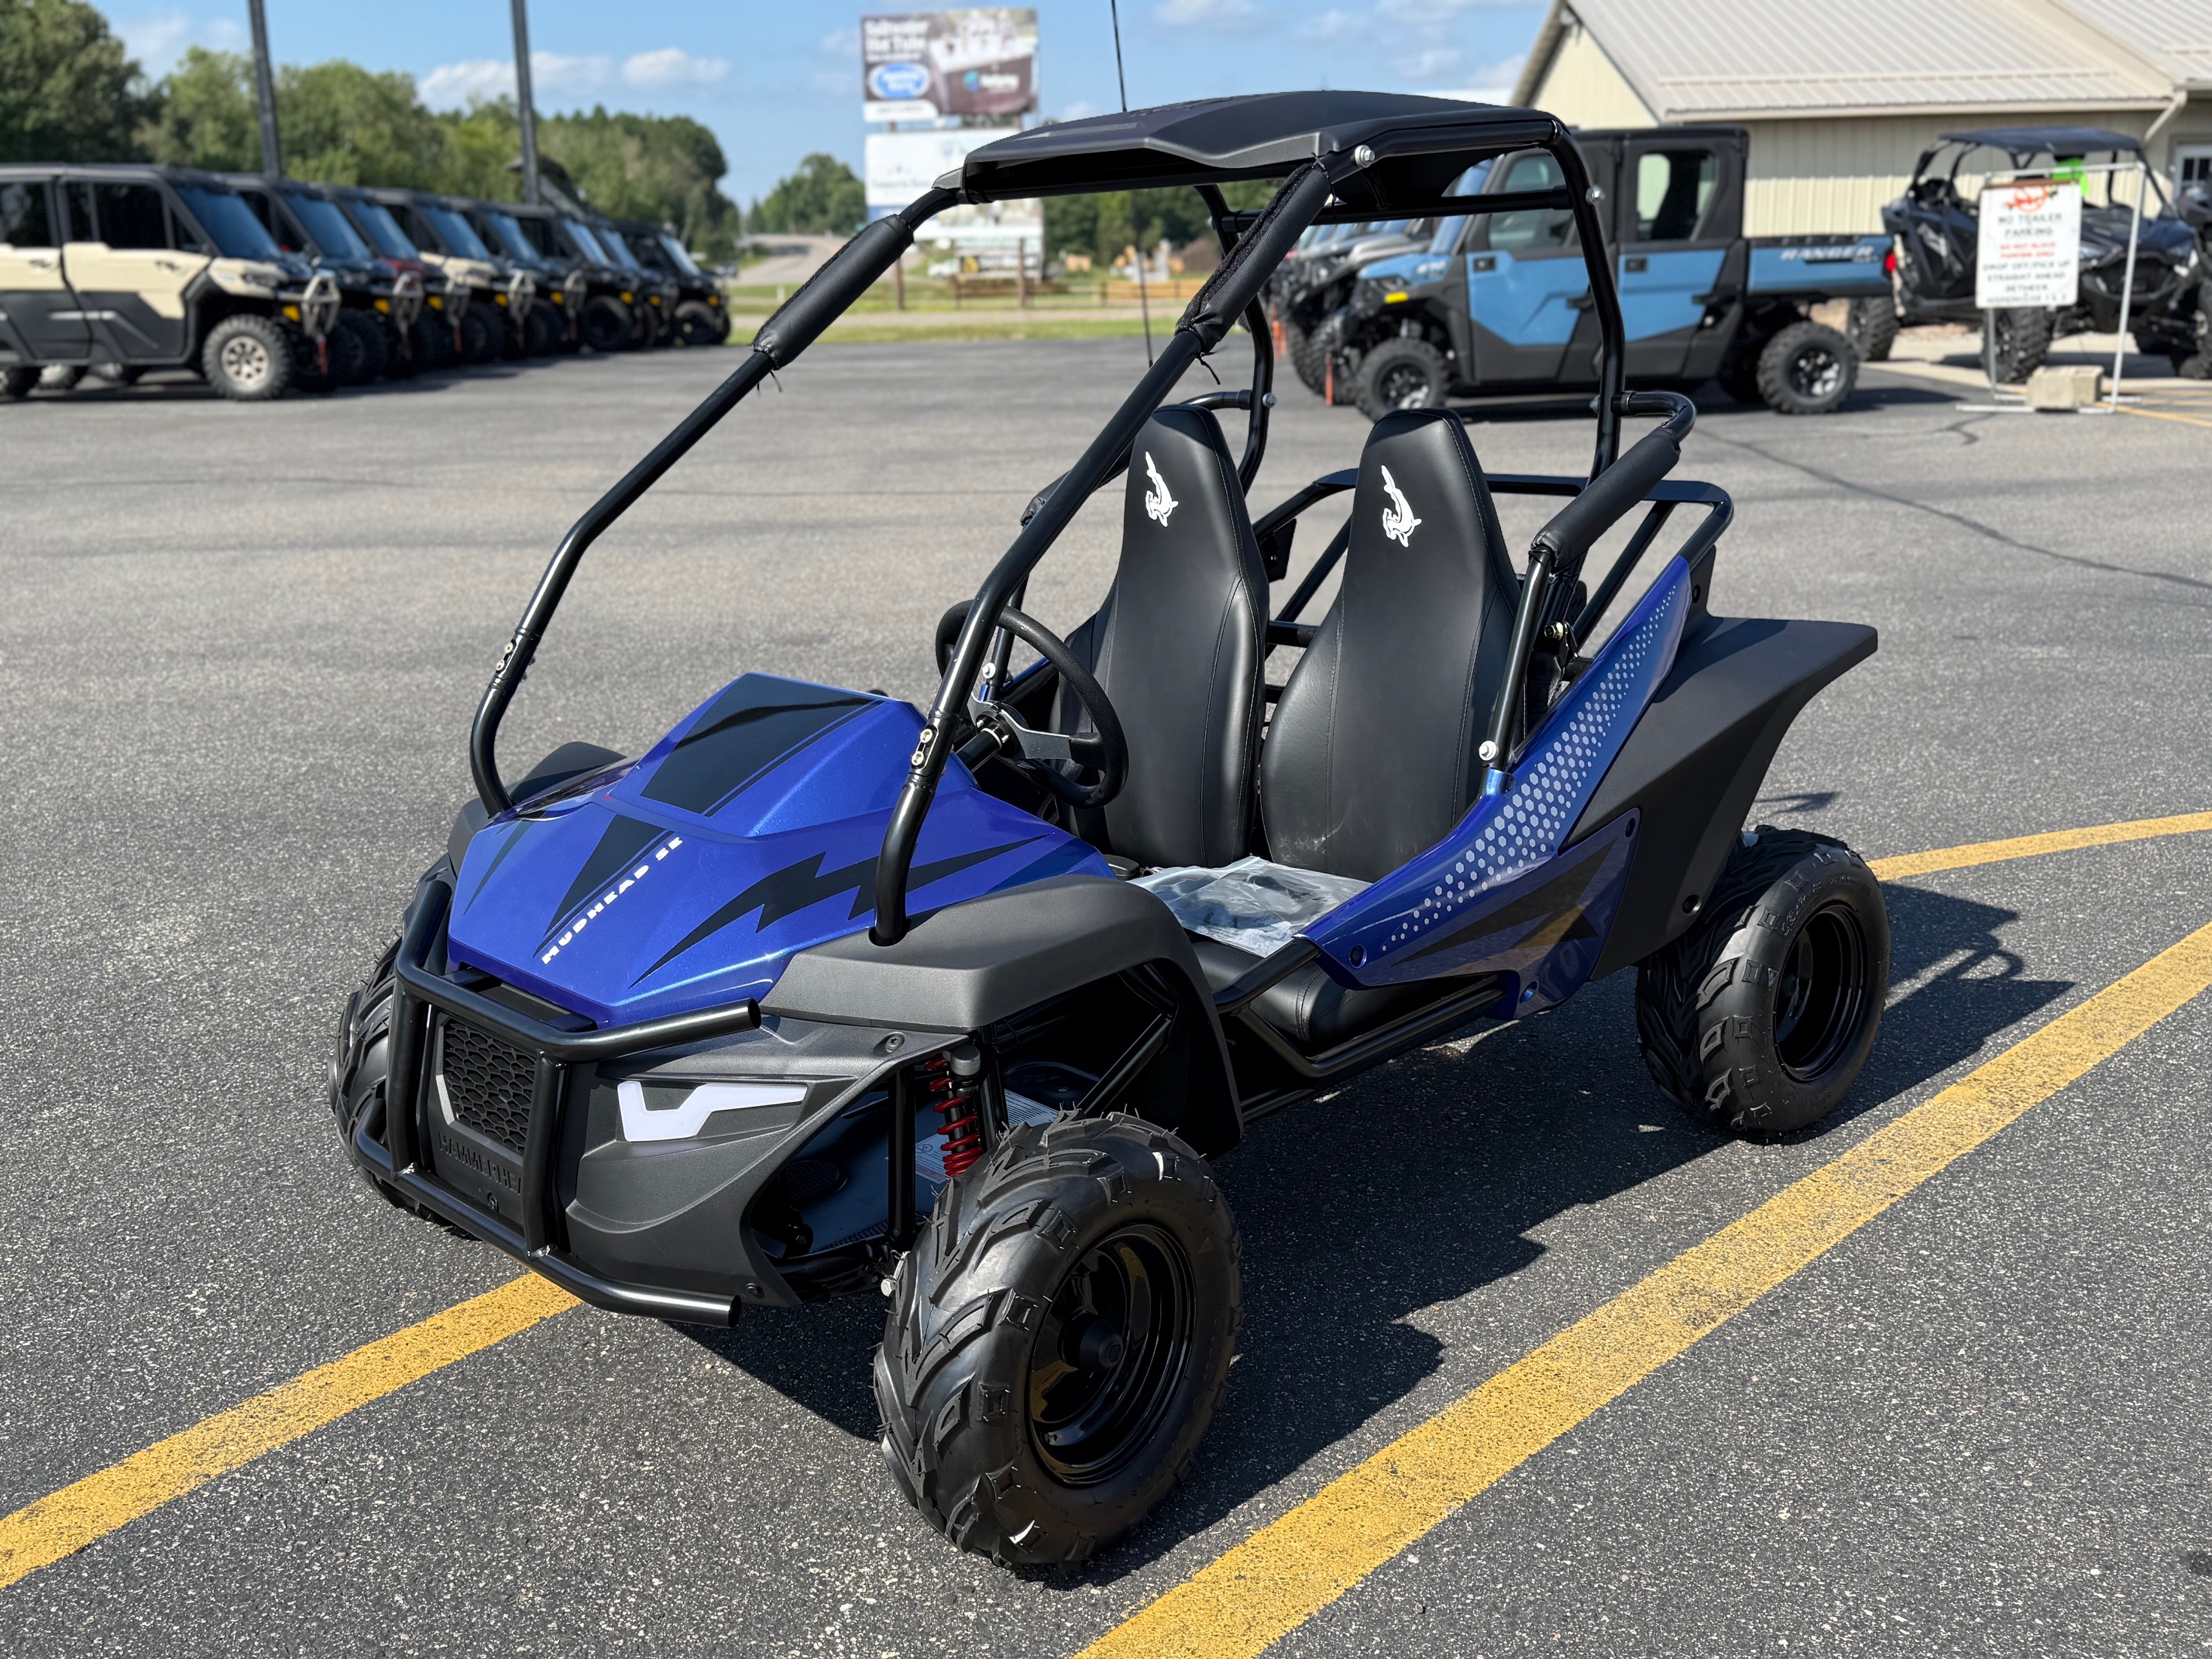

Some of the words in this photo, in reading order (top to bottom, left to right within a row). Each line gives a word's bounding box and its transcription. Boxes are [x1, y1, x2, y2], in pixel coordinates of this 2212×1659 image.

[2018, 214, 2062, 224] TRAILER
[2004, 227, 2053, 237] PARKING
[1780, 246, 1875, 260] RANGER
[541, 864, 650, 965] MUDHEAD
[655, 836, 683, 861] SE
